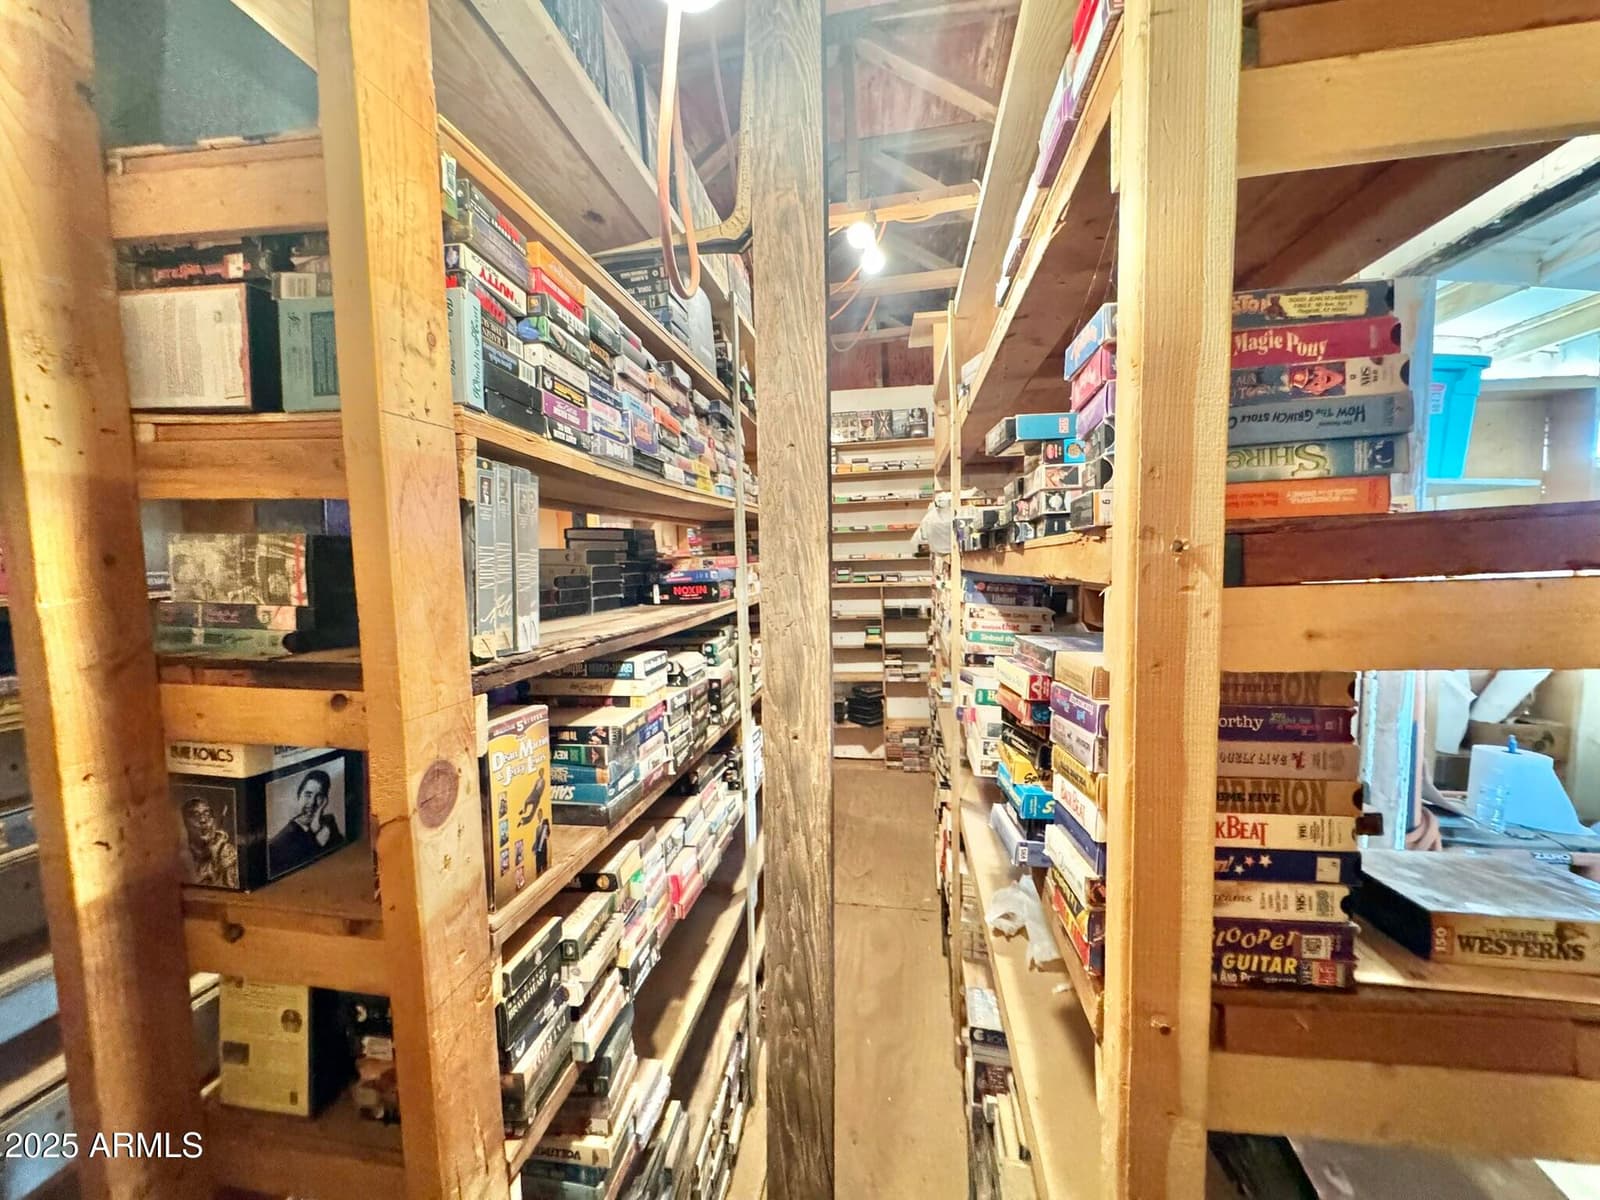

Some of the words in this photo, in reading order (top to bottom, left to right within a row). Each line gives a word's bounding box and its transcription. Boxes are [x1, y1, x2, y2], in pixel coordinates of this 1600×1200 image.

[1285, 331, 1329, 361] Pony
[1457, 934, 1586, 962] WESTERNS
[1221, 952, 1299, 975] GUITAR
